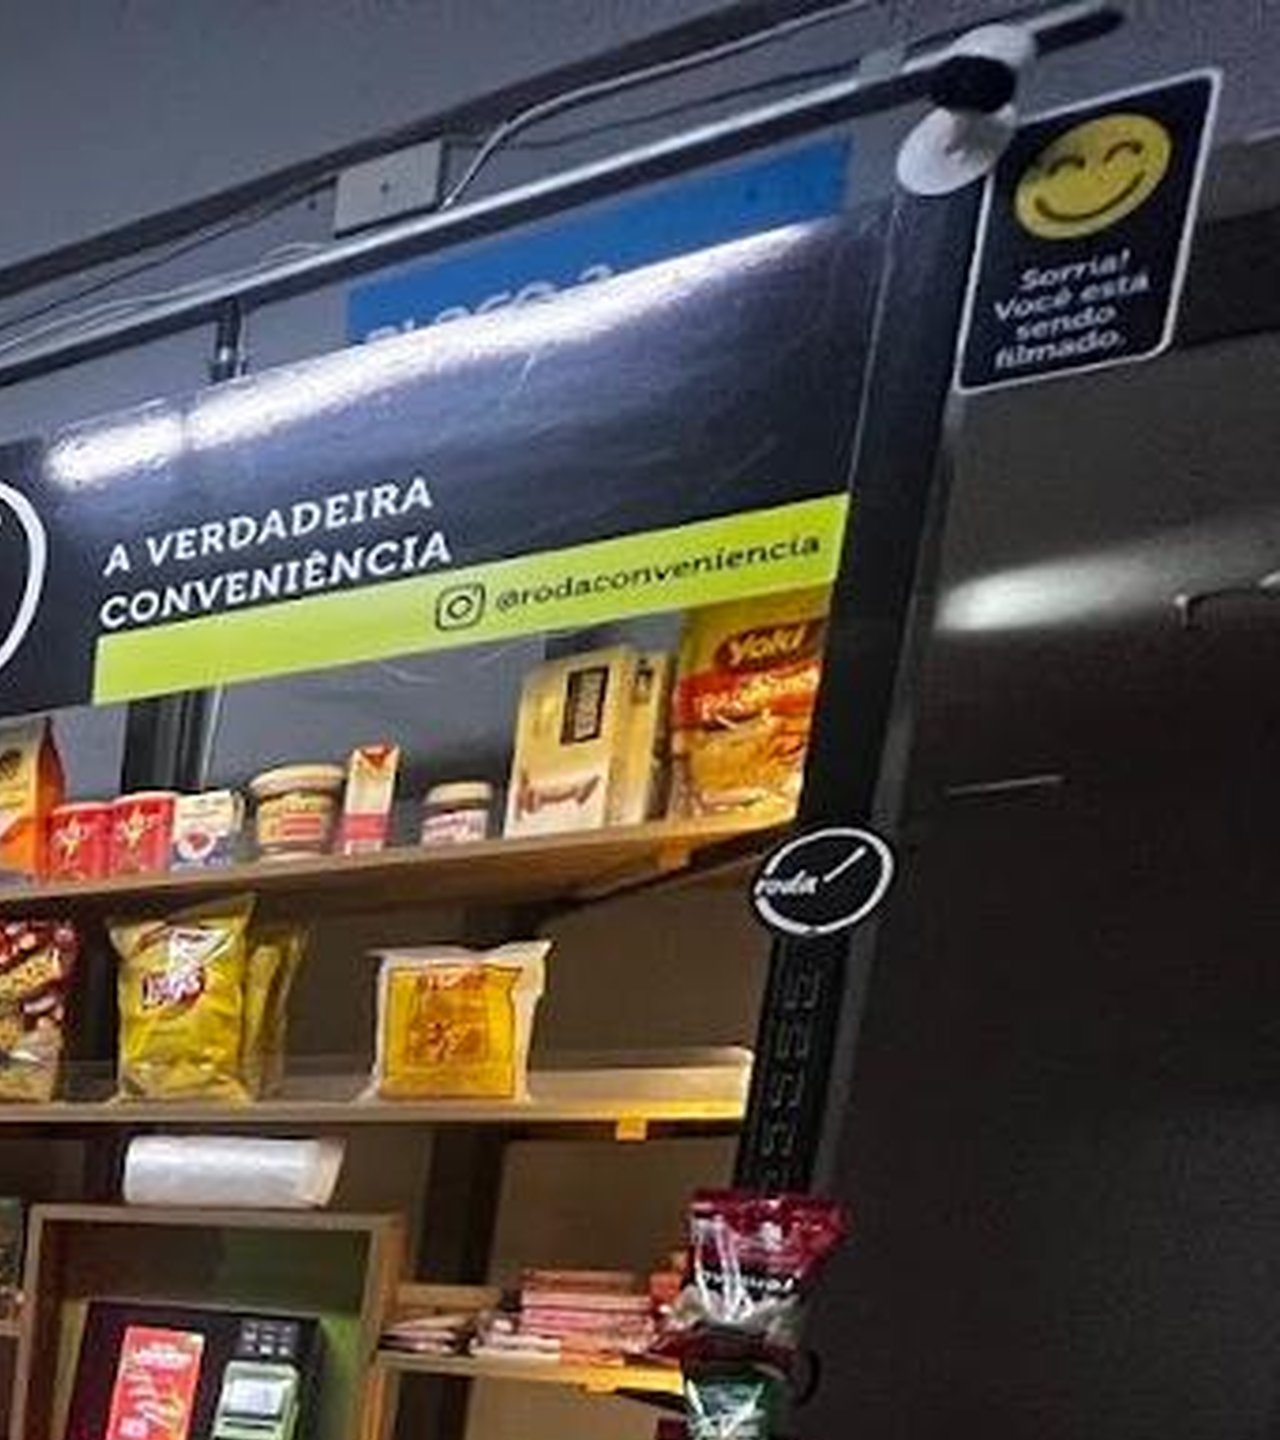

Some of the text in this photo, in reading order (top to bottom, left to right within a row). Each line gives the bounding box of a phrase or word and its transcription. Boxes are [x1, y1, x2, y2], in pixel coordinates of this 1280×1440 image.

[1020, 248, 1131, 290] Sorria!
[994, 289, 1072, 320] Você
[1016, 305, 1117, 341] sendo
[994, 329, 1127, 370] filmado.
[103, 477, 434, 577] A VERDADEIRA
[99, 531, 452, 629] CONVENIÊNCIA
[494, 533, 821, 613] @rodaconveniencia
